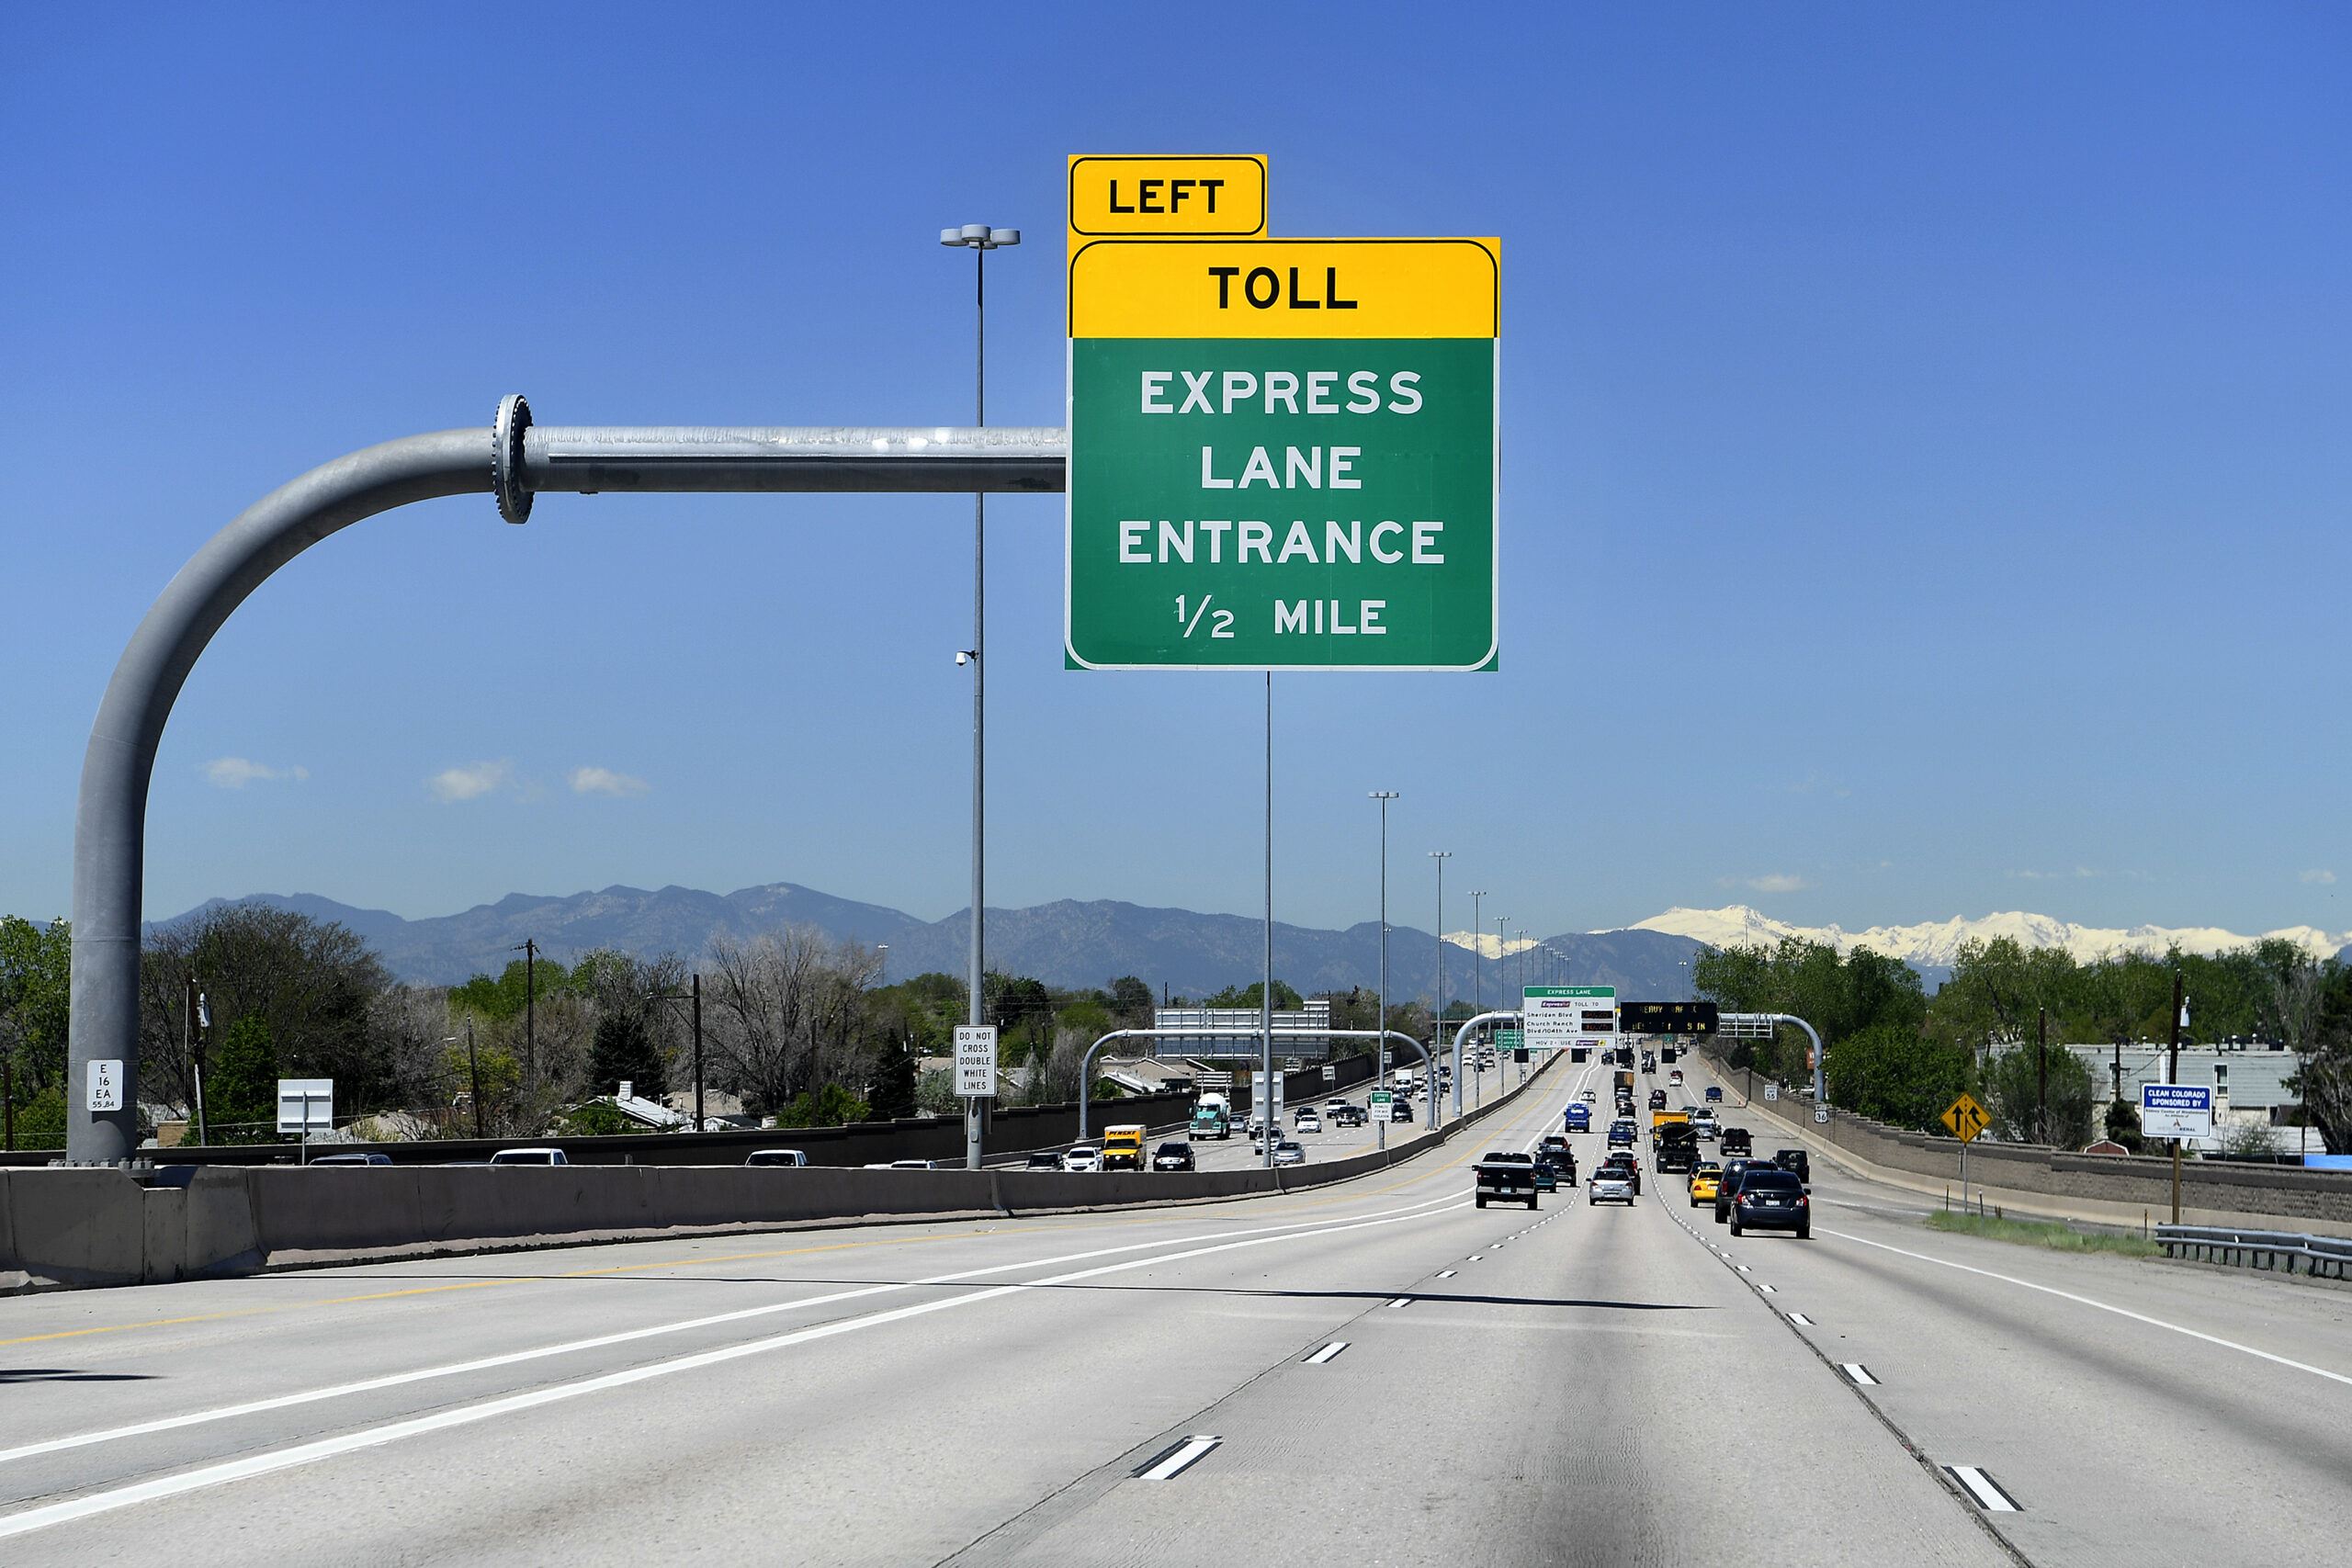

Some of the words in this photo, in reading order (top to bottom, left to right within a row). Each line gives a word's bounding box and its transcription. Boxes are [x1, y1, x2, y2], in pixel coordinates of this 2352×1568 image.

[1109, 179, 1225, 213] LEFT
[1208, 266, 1358, 310] TOLL
[1140, 370, 1424, 414] EXPRESS
[1201, 446, 1363, 490] LANE
[1118, 520, 1445, 565] ENTRANCE
[1175, 594, 1235, 638] 1/2
[1273, 599, 1387, 635] MILE
[959, 1032, 970, 1041] DO
[976, 1032, 991, 1041] NOT
[962, 1043, 989, 1053] CROSS
[959, 1056, 991, 1066] DOUBLE
[100, 1064, 107, 1074] E
[963, 1068, 987, 1077] WHITE
[98, 1077, 110, 1086] 16
[964, 1081, 987, 1090] LINES
[96, 1089, 111, 1099] EA
[2171, 1090, 2206, 1099] COLORADO
[2152, 1098, 2190, 1106] SPONSORED
[2192, 1099, 2202, 1107] BY
[1815, 1112, 1826, 1121] 36
